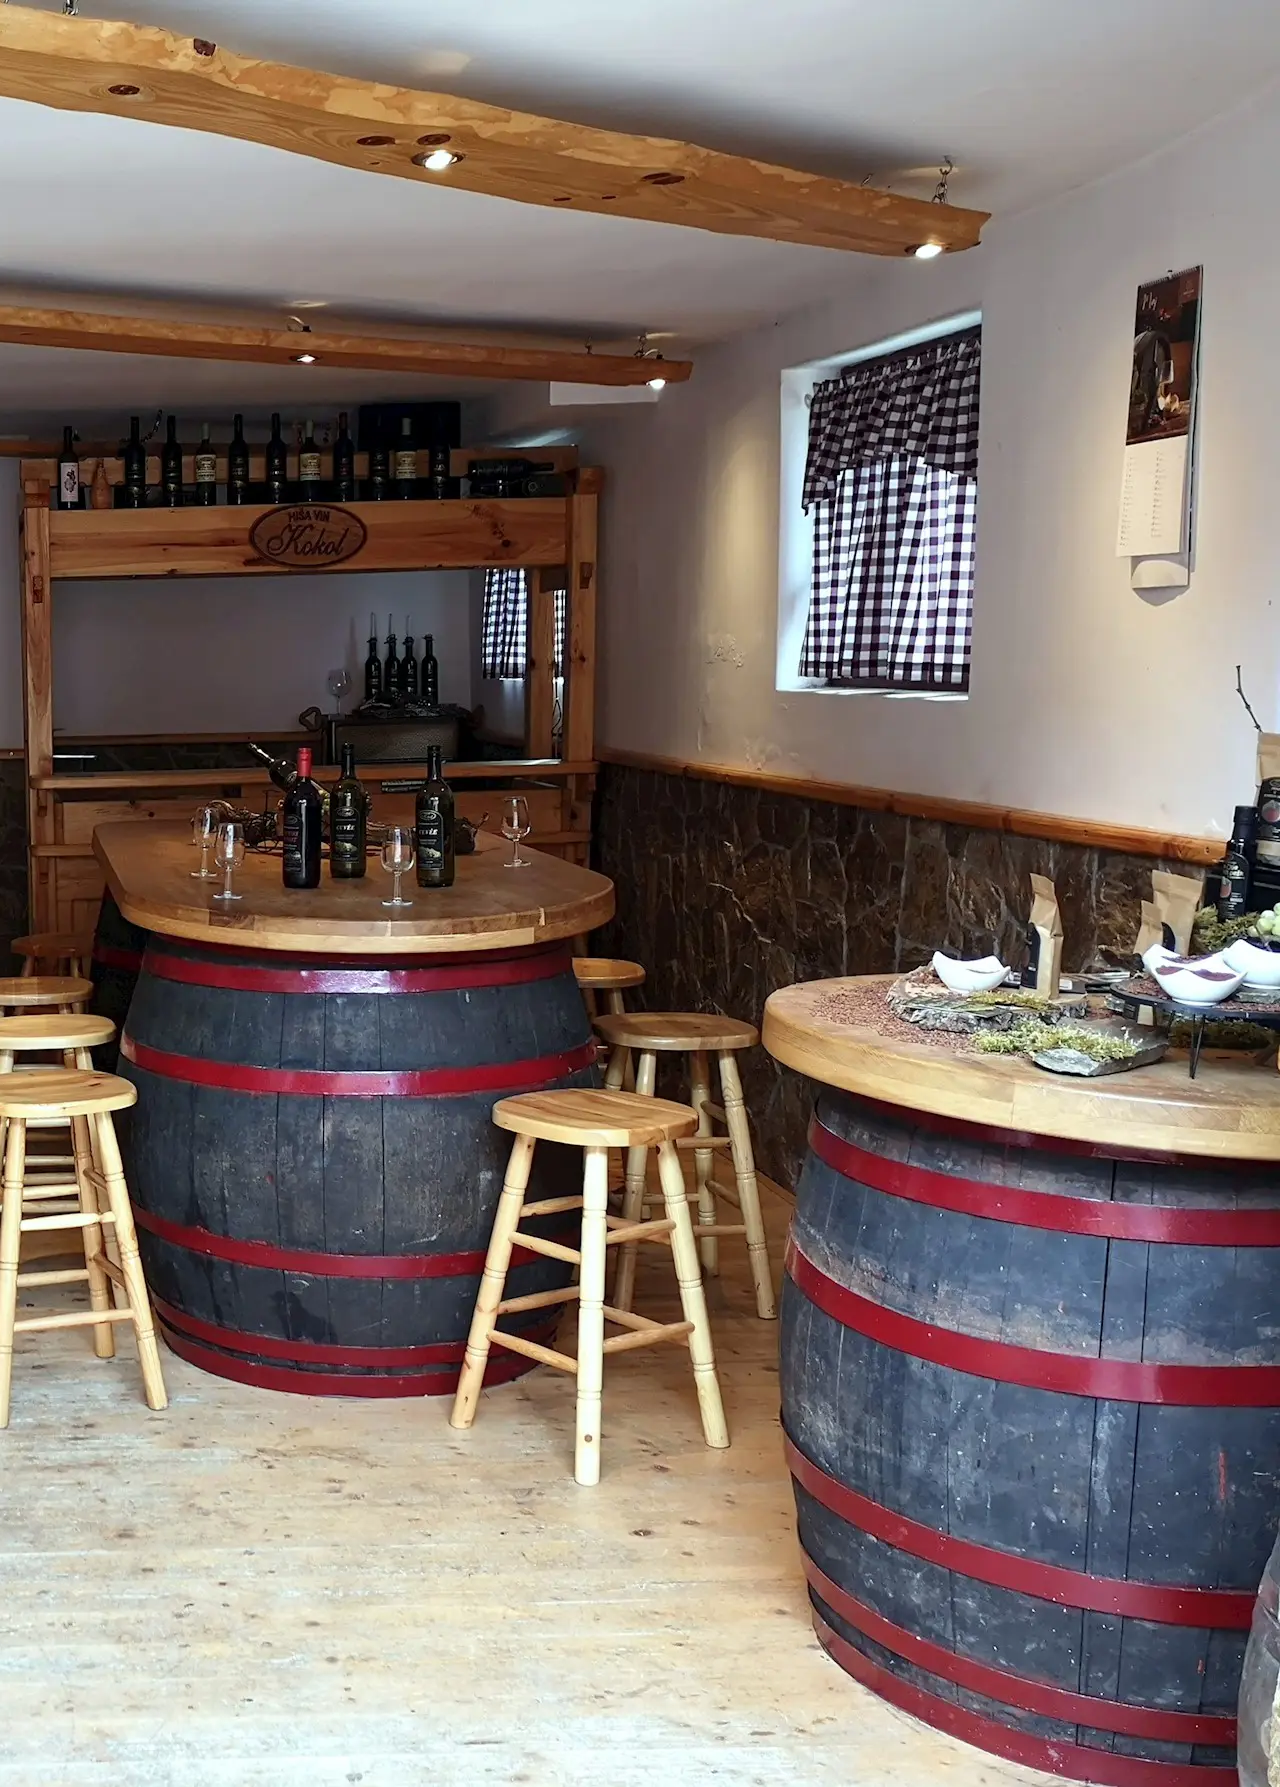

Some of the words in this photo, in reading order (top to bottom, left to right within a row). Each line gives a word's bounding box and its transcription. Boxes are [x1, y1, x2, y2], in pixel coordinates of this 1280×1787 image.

[288, 508, 312, 523] HIŠA
[314, 510, 331, 522] VIN
[266, 523, 350, 557] Kokol
